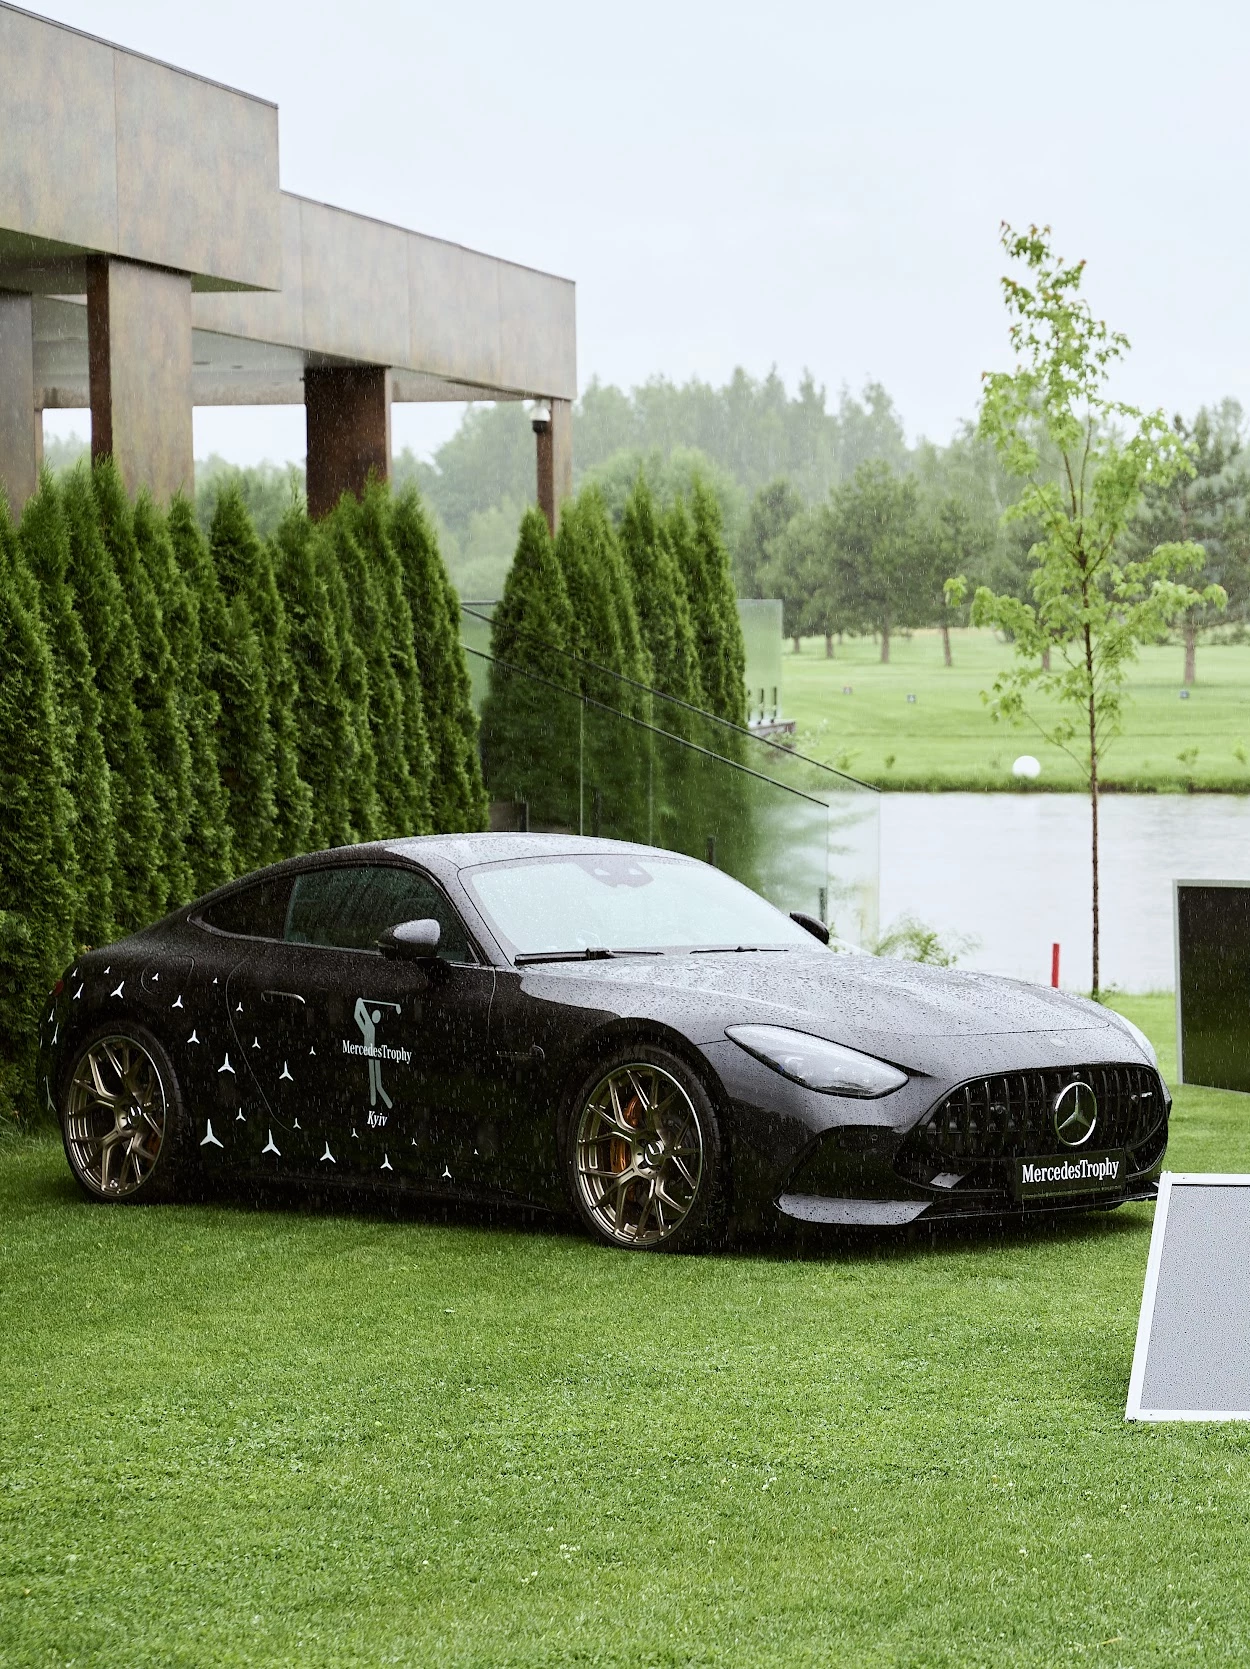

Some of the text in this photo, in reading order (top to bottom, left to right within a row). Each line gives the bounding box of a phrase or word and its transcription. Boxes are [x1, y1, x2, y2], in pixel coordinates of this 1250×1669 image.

[342, 1039, 412, 1064] MercedesTrophy
[367, 1110, 388, 1128] Kyiv
[1022, 1157, 1120, 1184] MercedesTrophy
